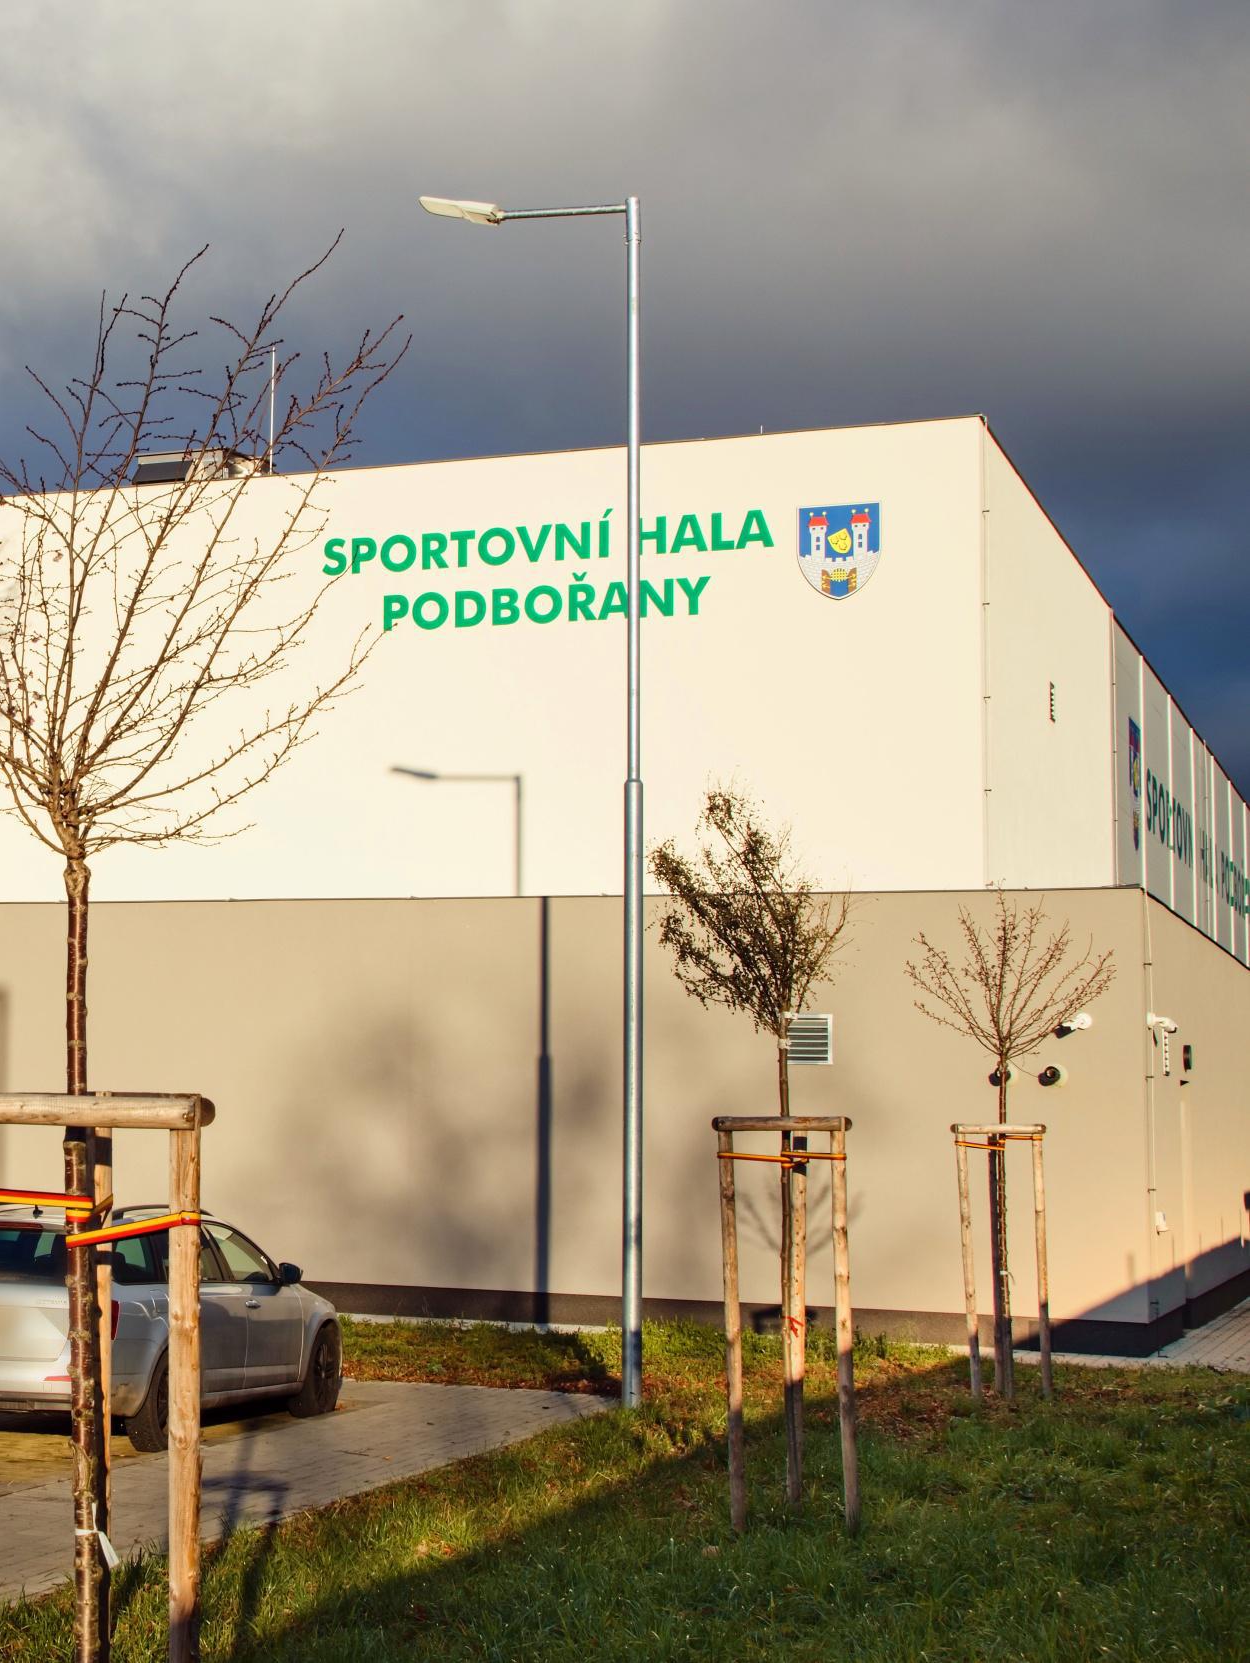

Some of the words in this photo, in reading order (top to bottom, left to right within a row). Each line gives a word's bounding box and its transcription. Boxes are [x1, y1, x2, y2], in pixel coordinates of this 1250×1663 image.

[322, 507, 613, 576] SPORTOVNÍ
[639, 509, 775, 555] HALA
[383, 571, 712, 632] PODBOŘANY
